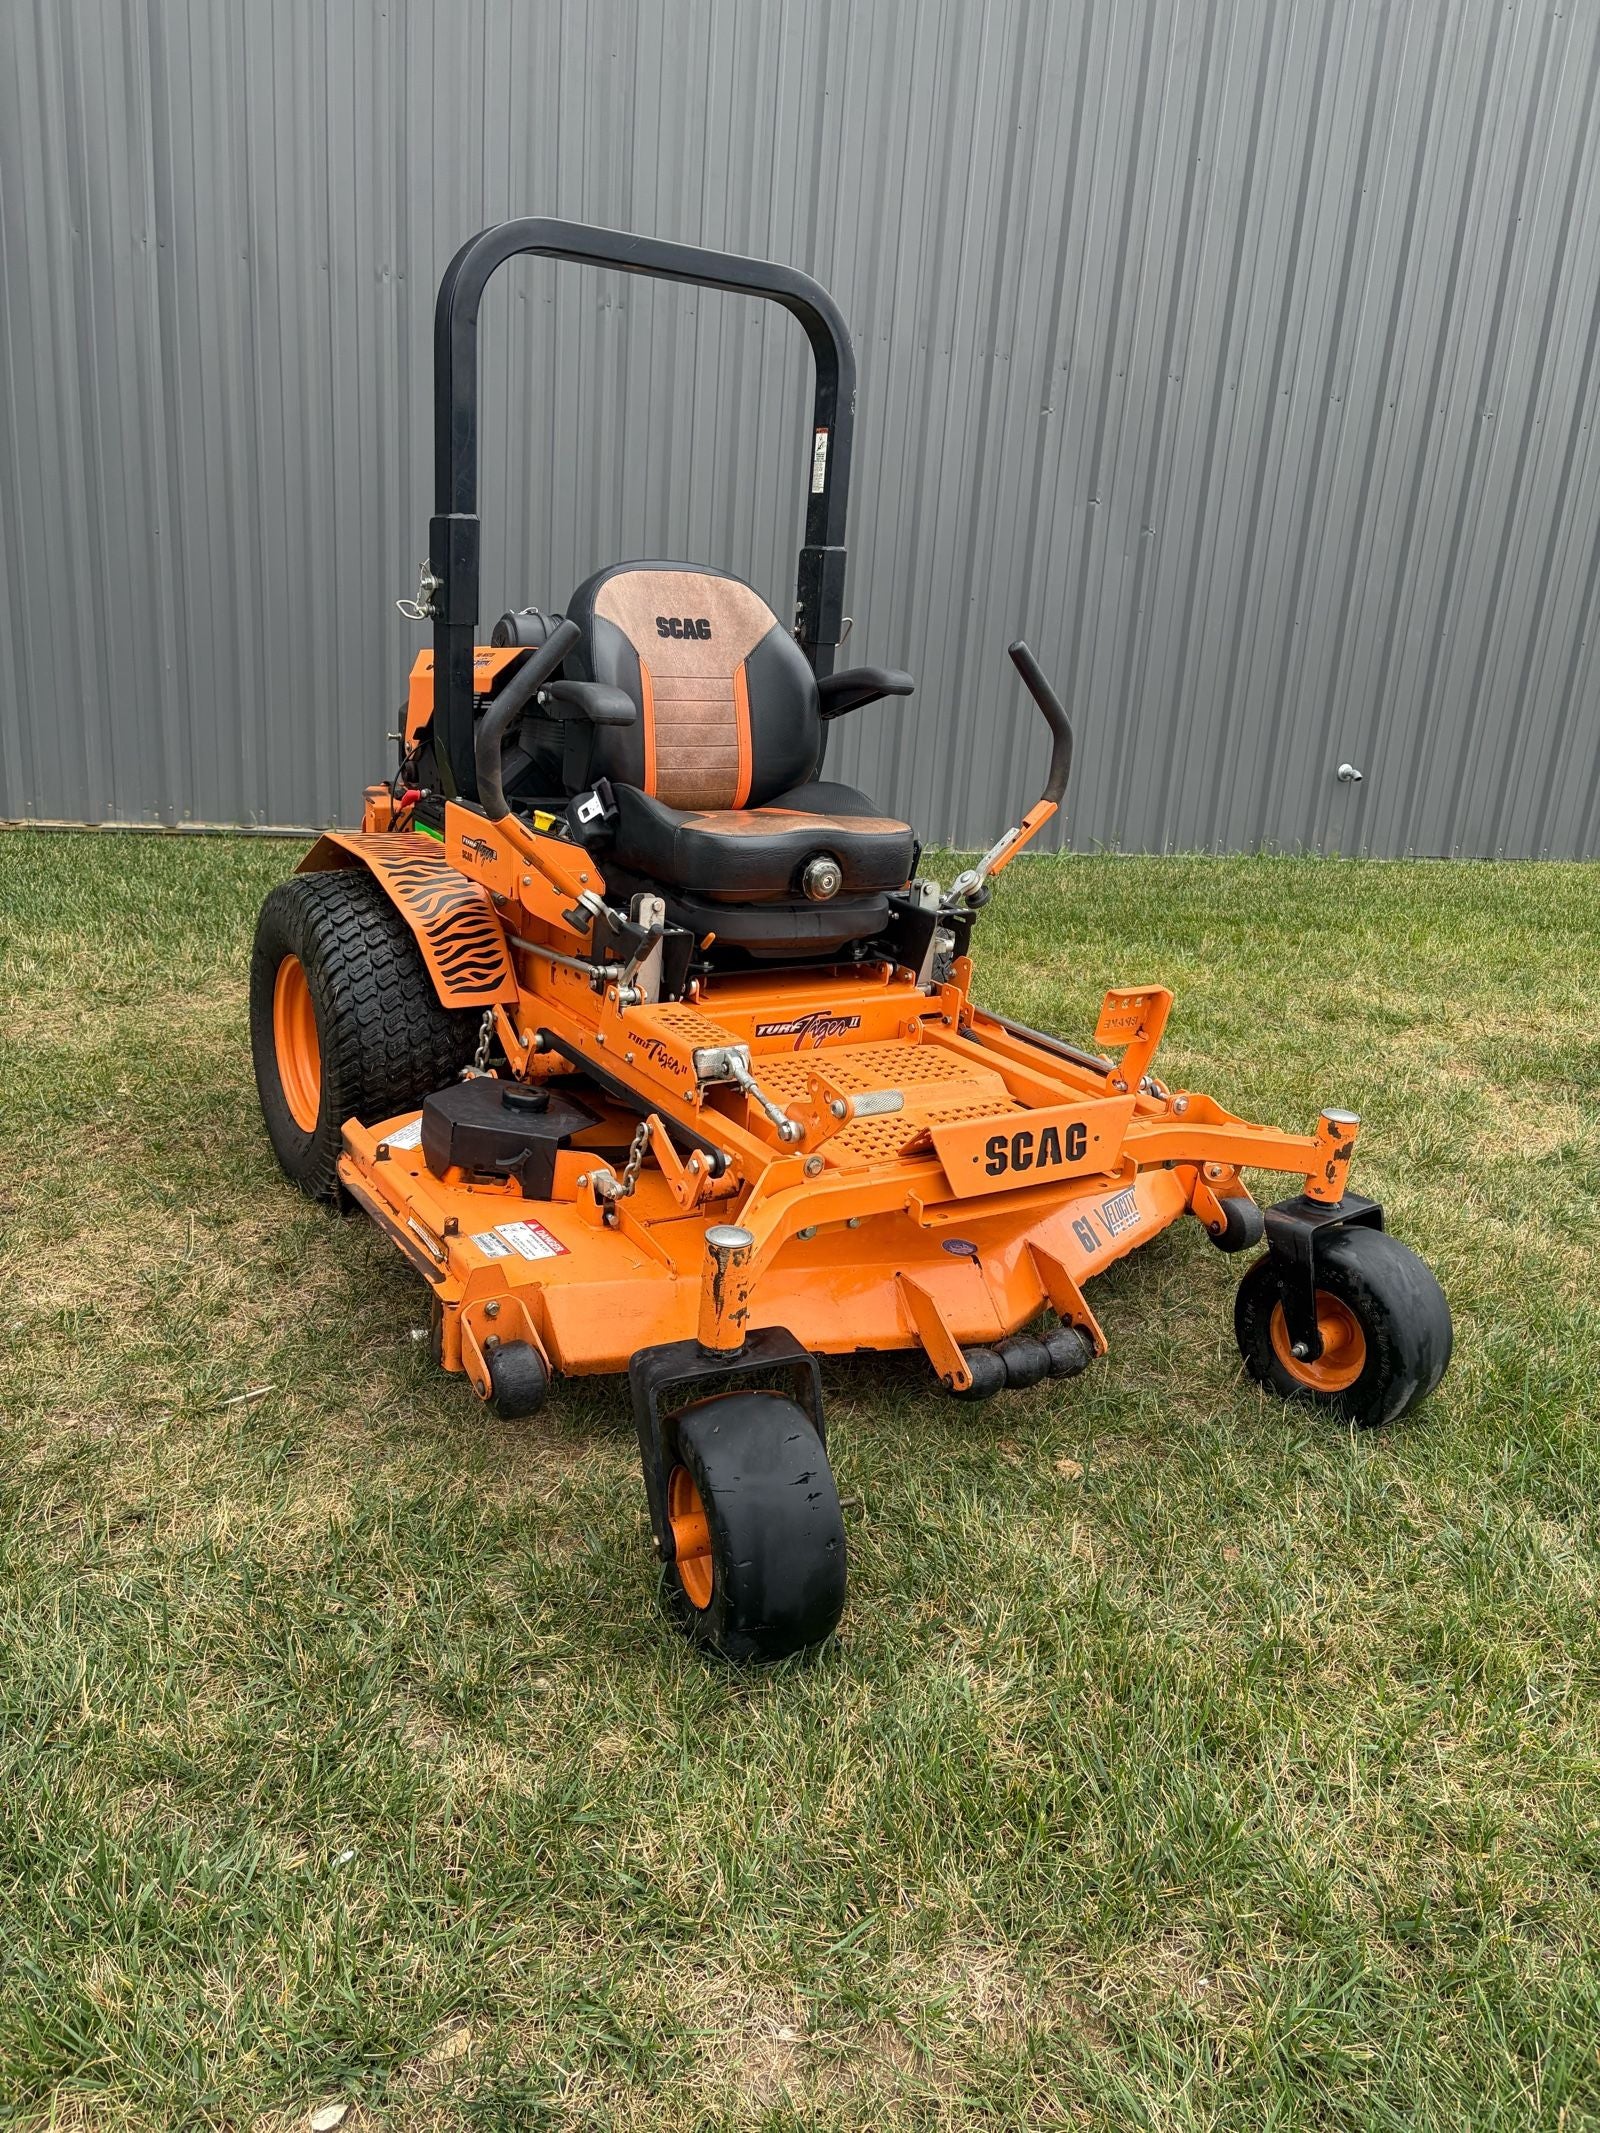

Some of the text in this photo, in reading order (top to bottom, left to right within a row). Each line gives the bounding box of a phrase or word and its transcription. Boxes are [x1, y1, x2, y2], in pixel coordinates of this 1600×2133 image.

[656, 616, 712, 640] SCAG
[756, 1010, 859, 1051] TURF Tiger II
[628, 1032, 651, 1049] TURF
[646, 1038, 680, 1075] Tiger
[985, 1122, 1088, 1176] SCAG
[1072, 1185, 1136, 1253] 61 VELOCITY
[536, 1229, 564, 1252] DANGER
